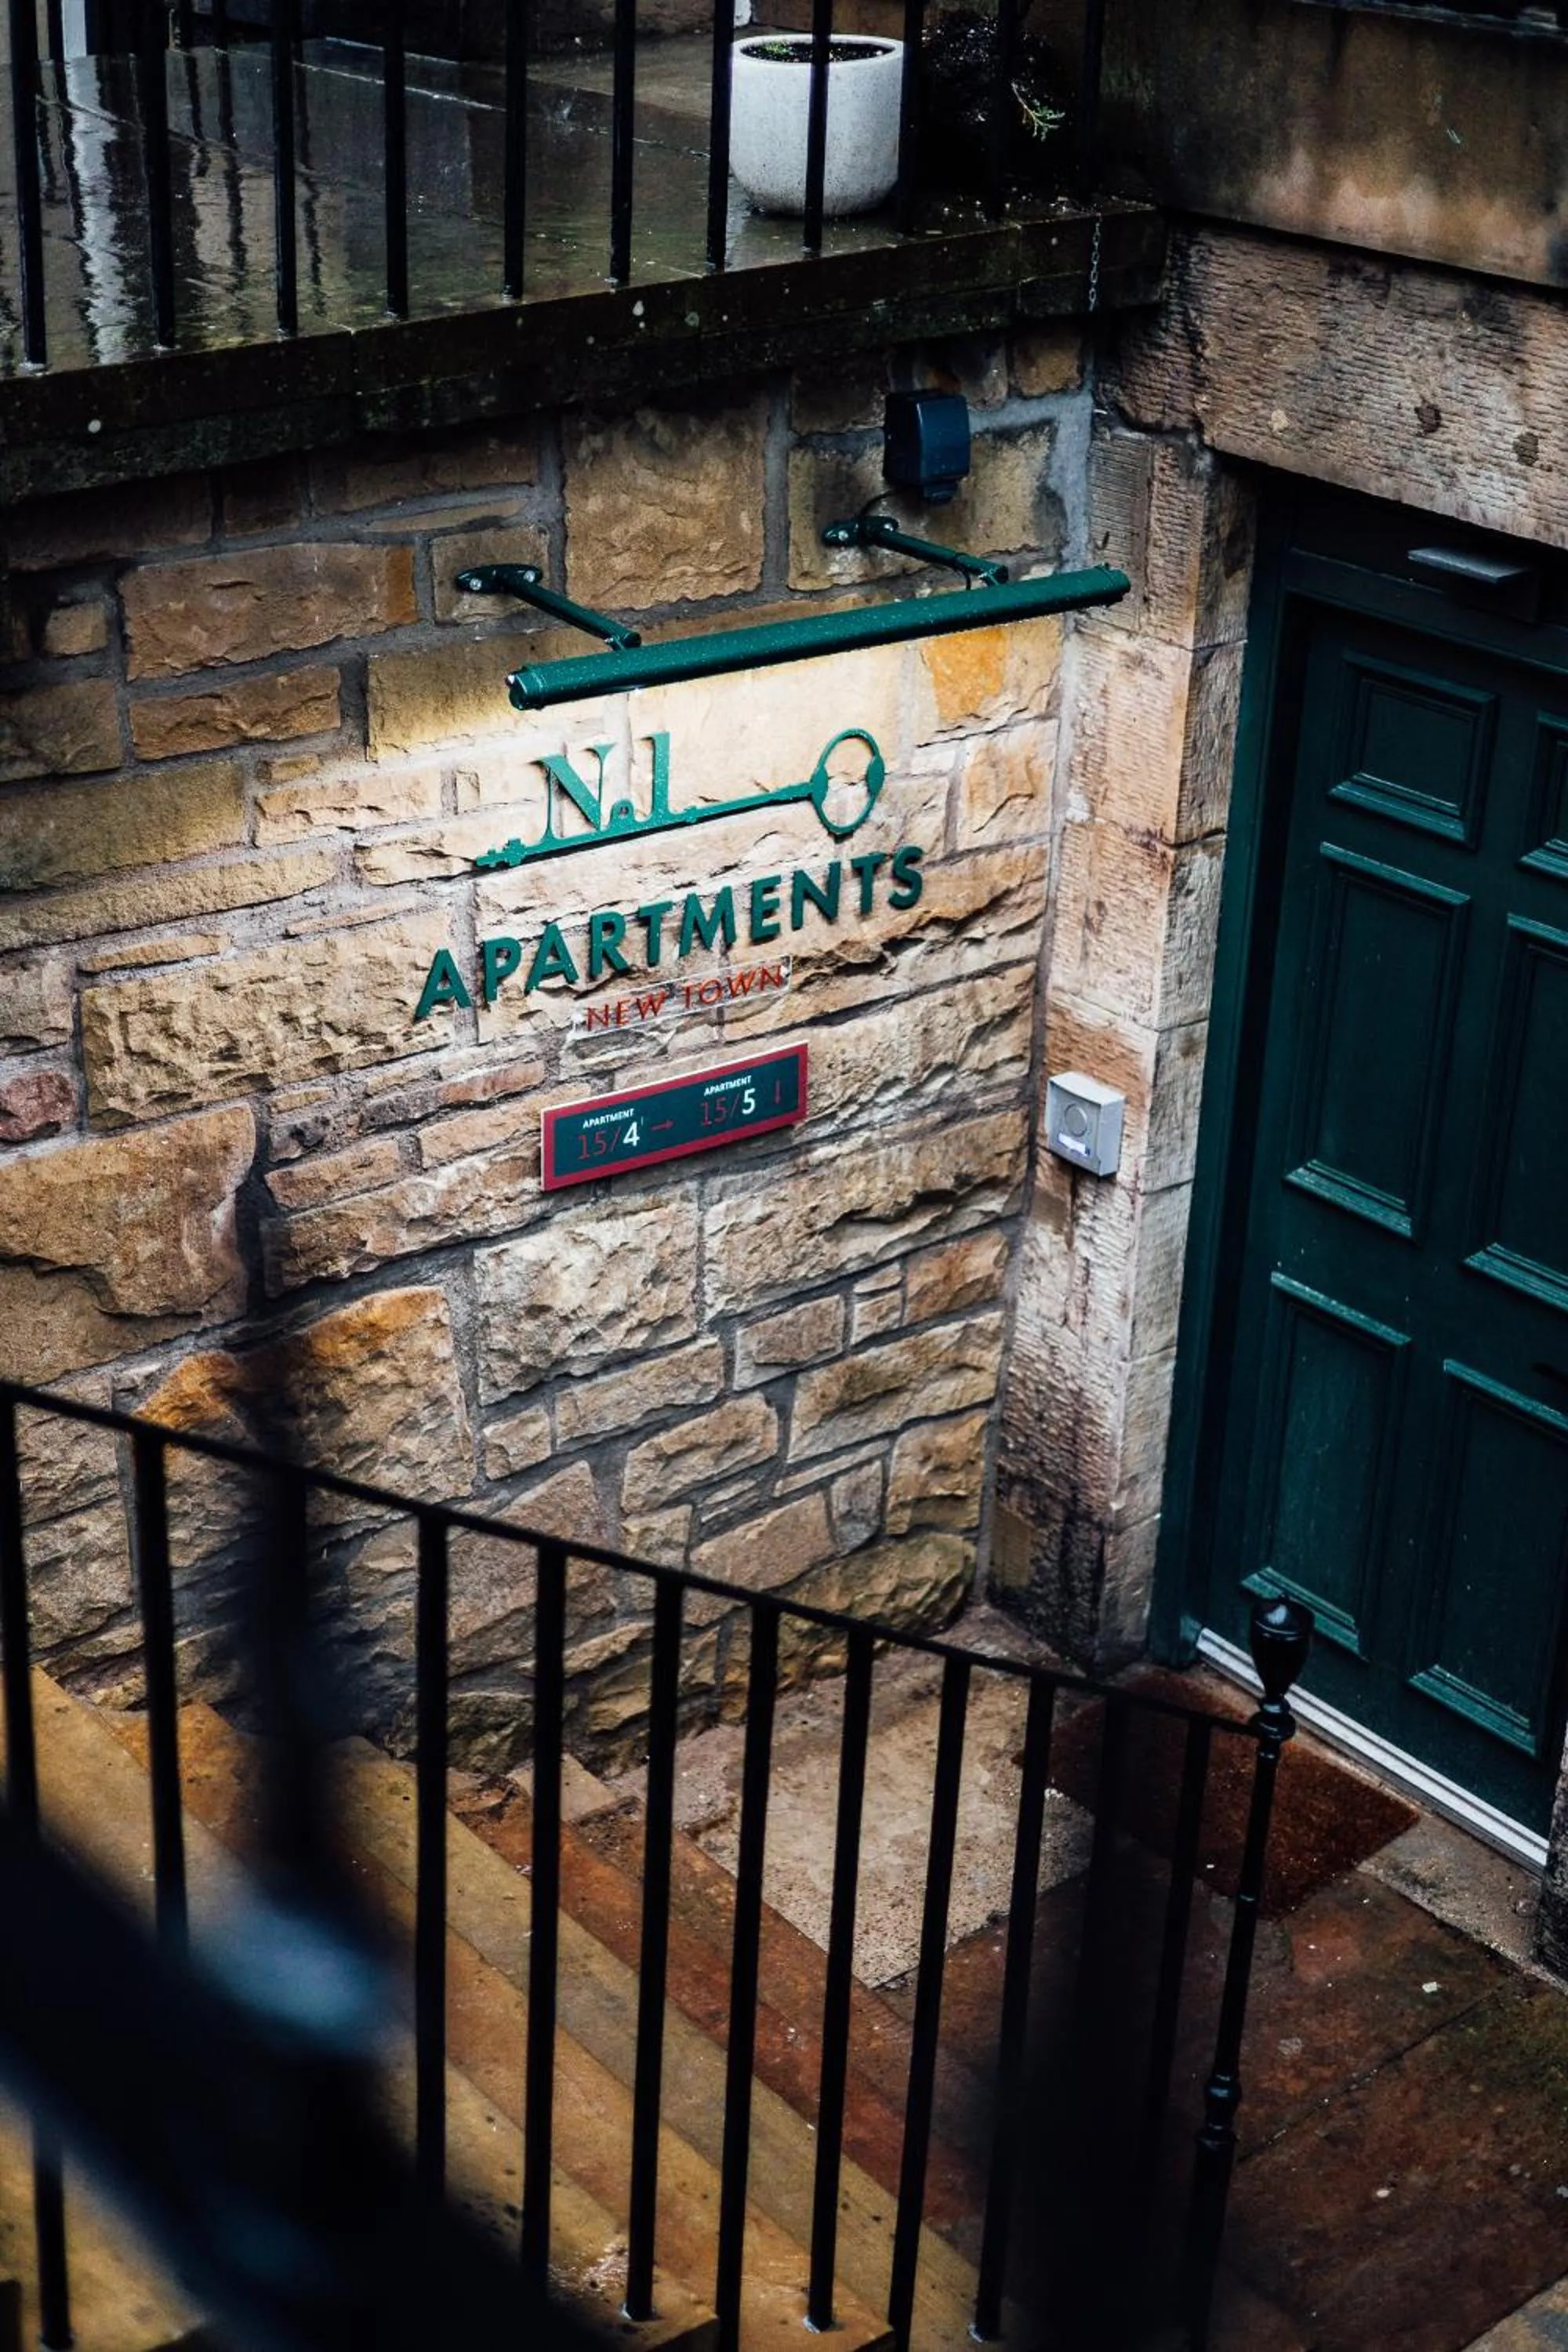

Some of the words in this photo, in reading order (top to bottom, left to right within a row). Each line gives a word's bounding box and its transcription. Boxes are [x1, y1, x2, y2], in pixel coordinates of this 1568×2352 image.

[414, 845, 924, 1020] APARTMENTS
[586, 990, 666, 1032] NEW
[683, 964, 784, 1010] TOWN
[704, 1075, 753, 1096] APARTMENT
[583, 1108, 635, 1129] APARTMENT
[700, 1087, 757, 1126] 15/5
[577, 1121, 641, 1160] 15/4
